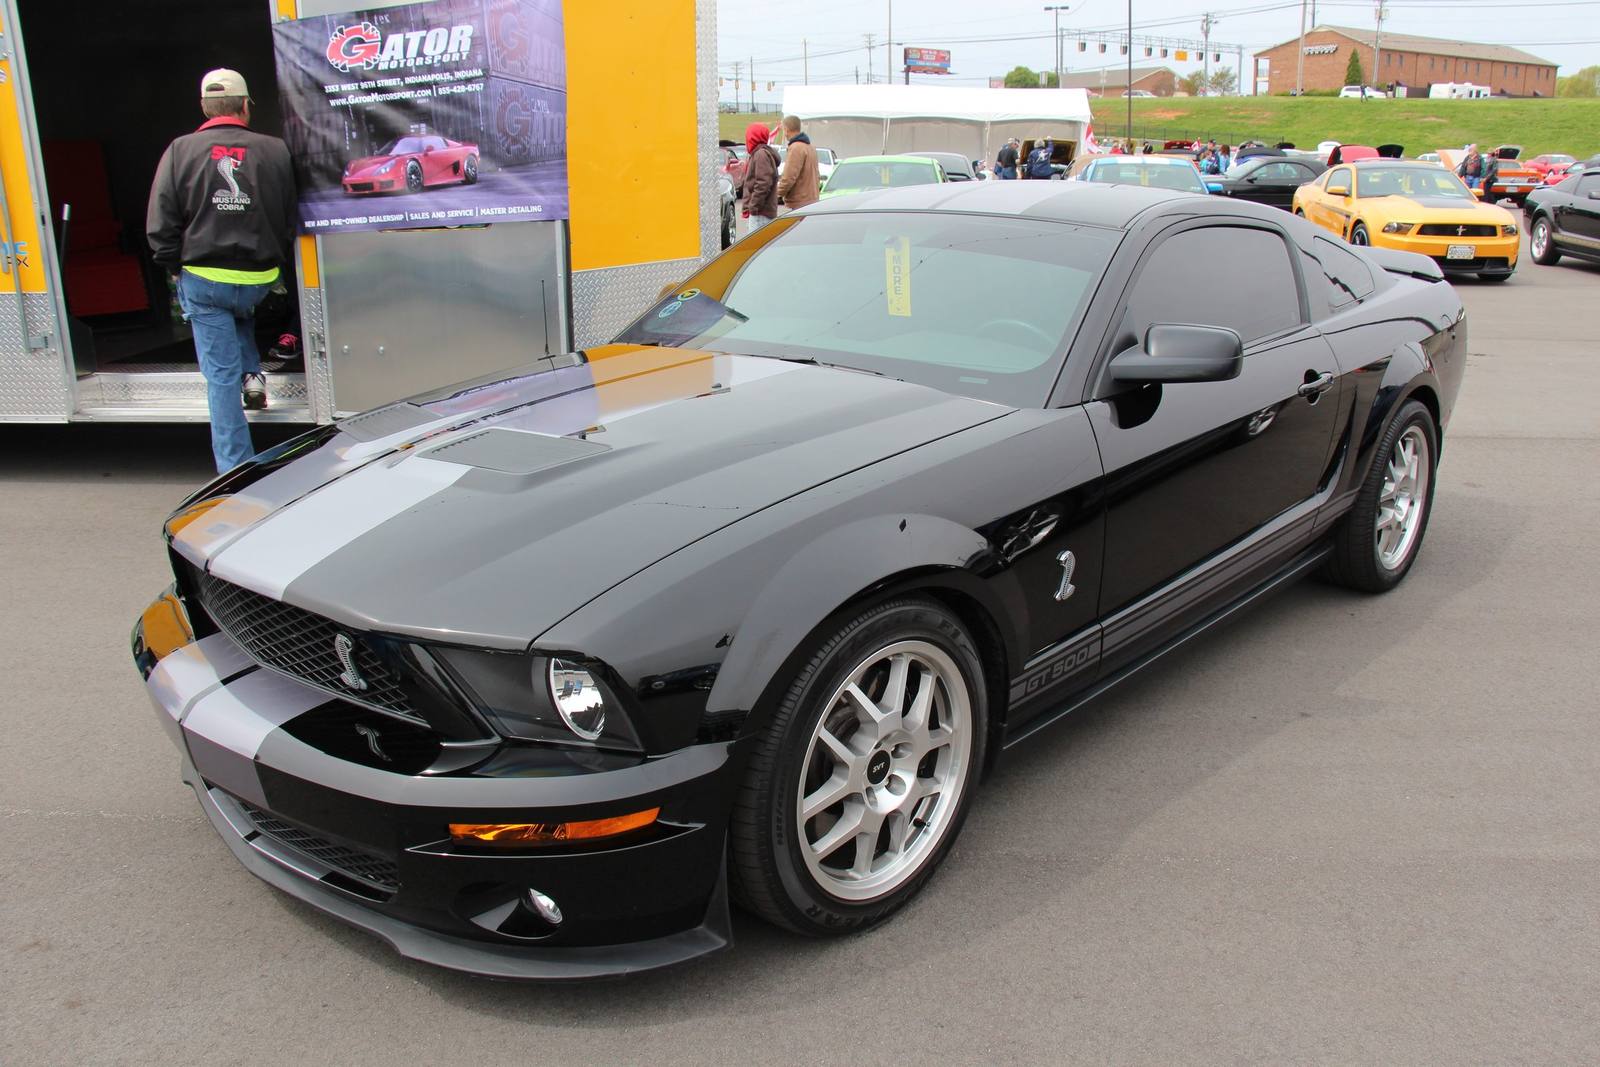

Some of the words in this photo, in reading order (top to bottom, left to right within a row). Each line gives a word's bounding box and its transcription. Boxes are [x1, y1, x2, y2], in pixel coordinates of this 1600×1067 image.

[326, 21, 474, 73] GATOR
[378, 51, 470, 71] MOTORSPORT
[341, 82, 359, 91] WEST
[377, 78, 404, 87] STREET,
[405, 73, 454, 84] INDIANAPOLIS,
[454, 69, 484, 80] INDIANA
[438, 83, 484, 95] 855-428-6767
[211, 145, 246, 160] SVT
[316, 219, 330, 227] AND
[330, 216, 368, 226] PRE-OWNED
[368, 214, 404, 223] DEALERSHIP
[410, 212, 430, 220] SALES
[431, 211, 446, 219] AND
[447, 209, 474, 218] SERVICE
[480, 207, 506, 215] MASTER
[508, 205, 543, 214] DETAILING
[1026, 646, 1090, 693] GT500
[872, 761, 885, 773] SVT
